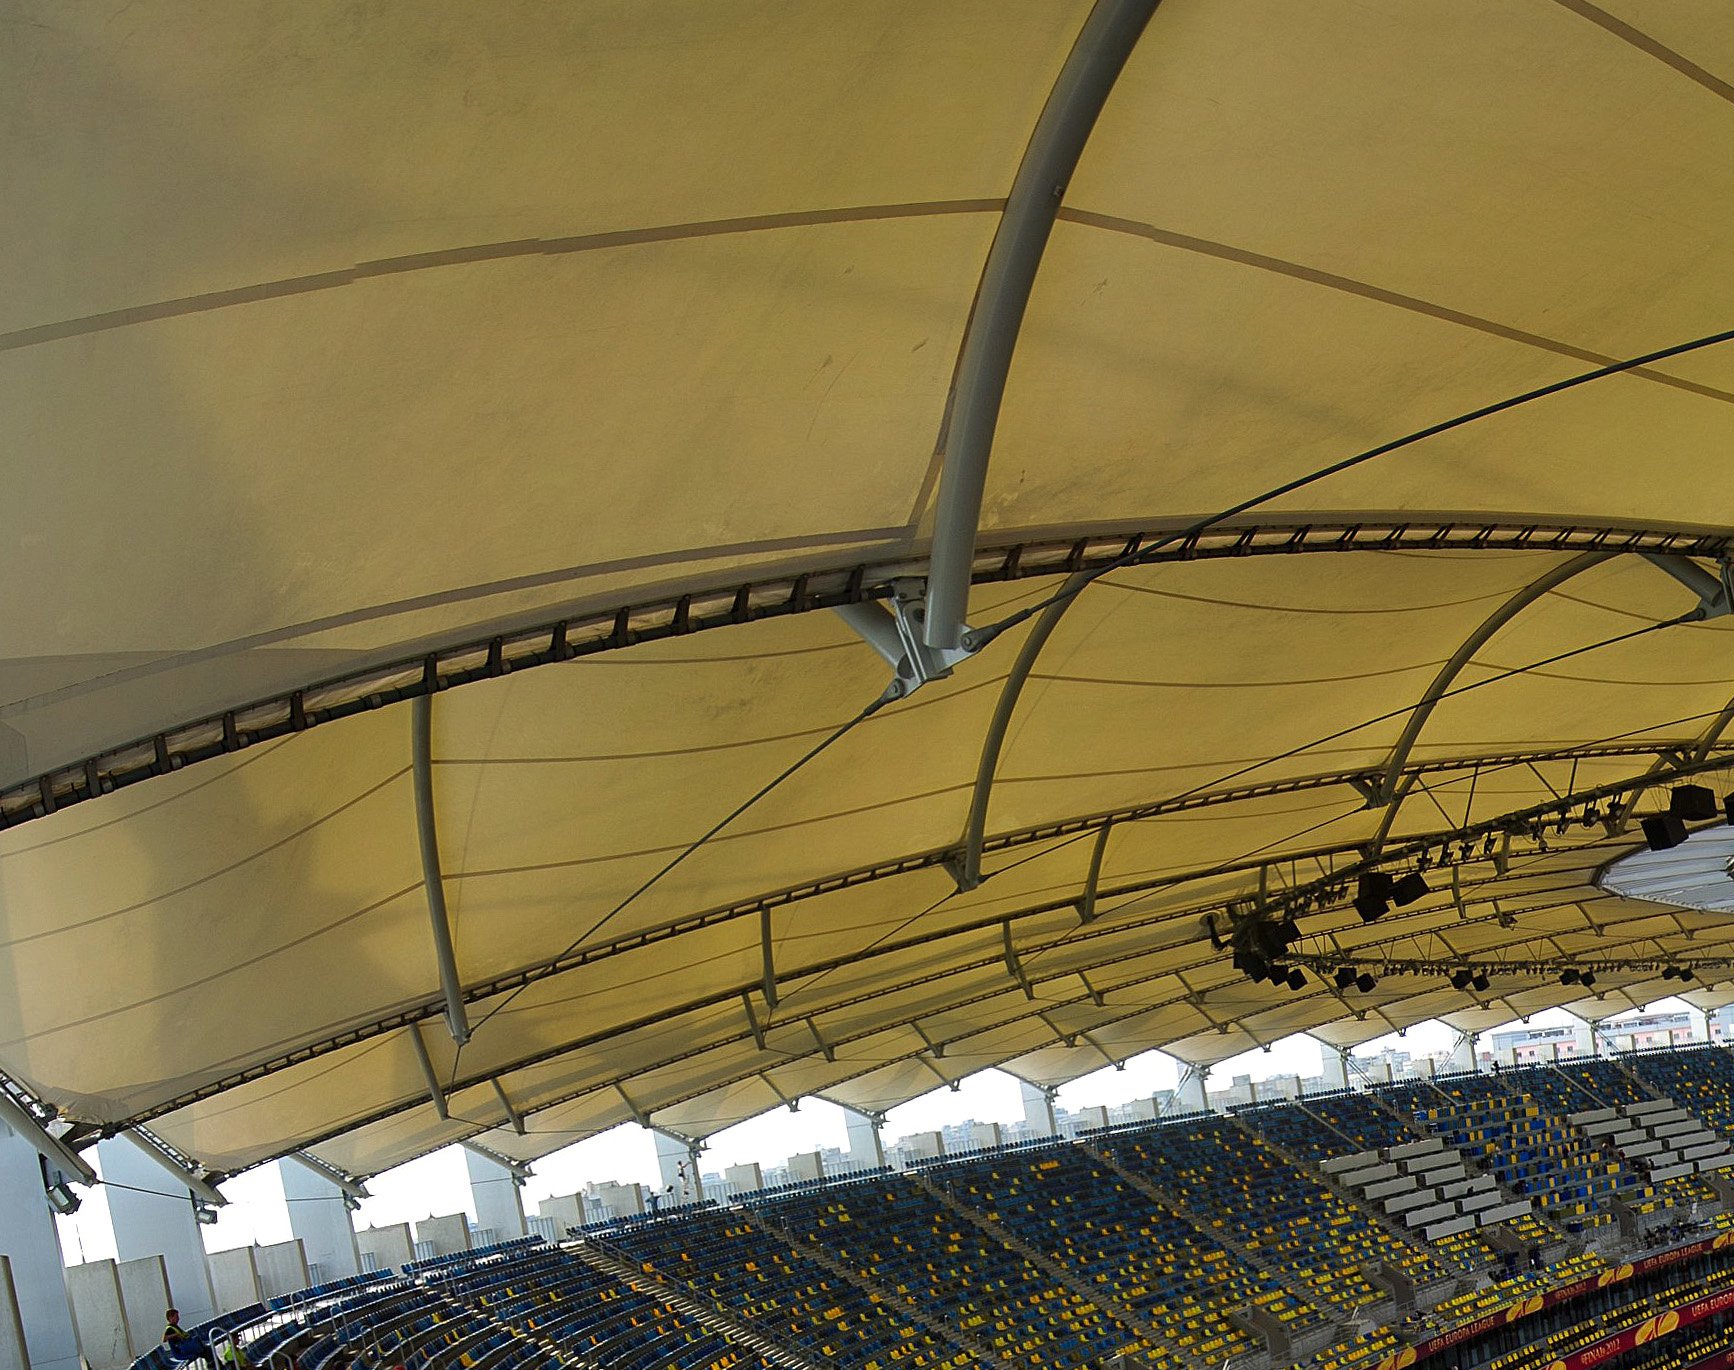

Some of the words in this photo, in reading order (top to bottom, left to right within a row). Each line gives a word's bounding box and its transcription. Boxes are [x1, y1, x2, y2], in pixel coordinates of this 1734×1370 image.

[1691, 1302, 1709, 1317] UEFA
[1428, 1336, 1444, 1350] UEFA
[1446, 1326, 1470, 1345] EUROPA
[1470, 1316, 1495, 1334] LEAGUE
